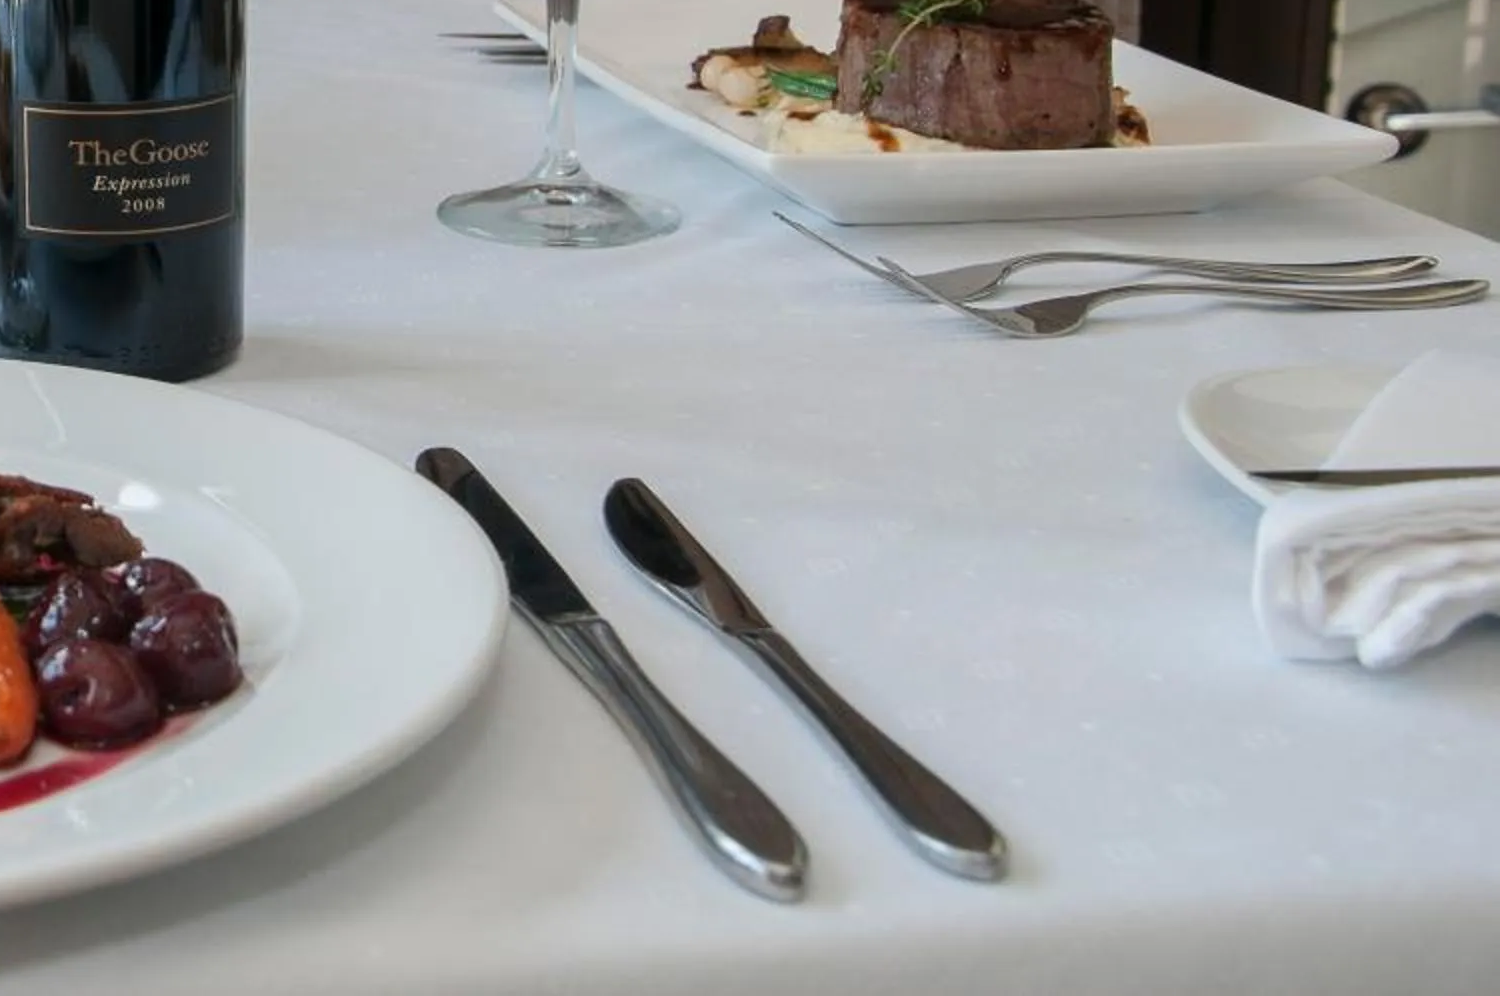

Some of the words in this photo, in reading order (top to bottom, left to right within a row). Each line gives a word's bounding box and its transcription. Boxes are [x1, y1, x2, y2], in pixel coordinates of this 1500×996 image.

[67, 138, 210, 167] TheGoose
[92, 172, 192, 196] Expression
[121, 197, 166, 213] 2008
